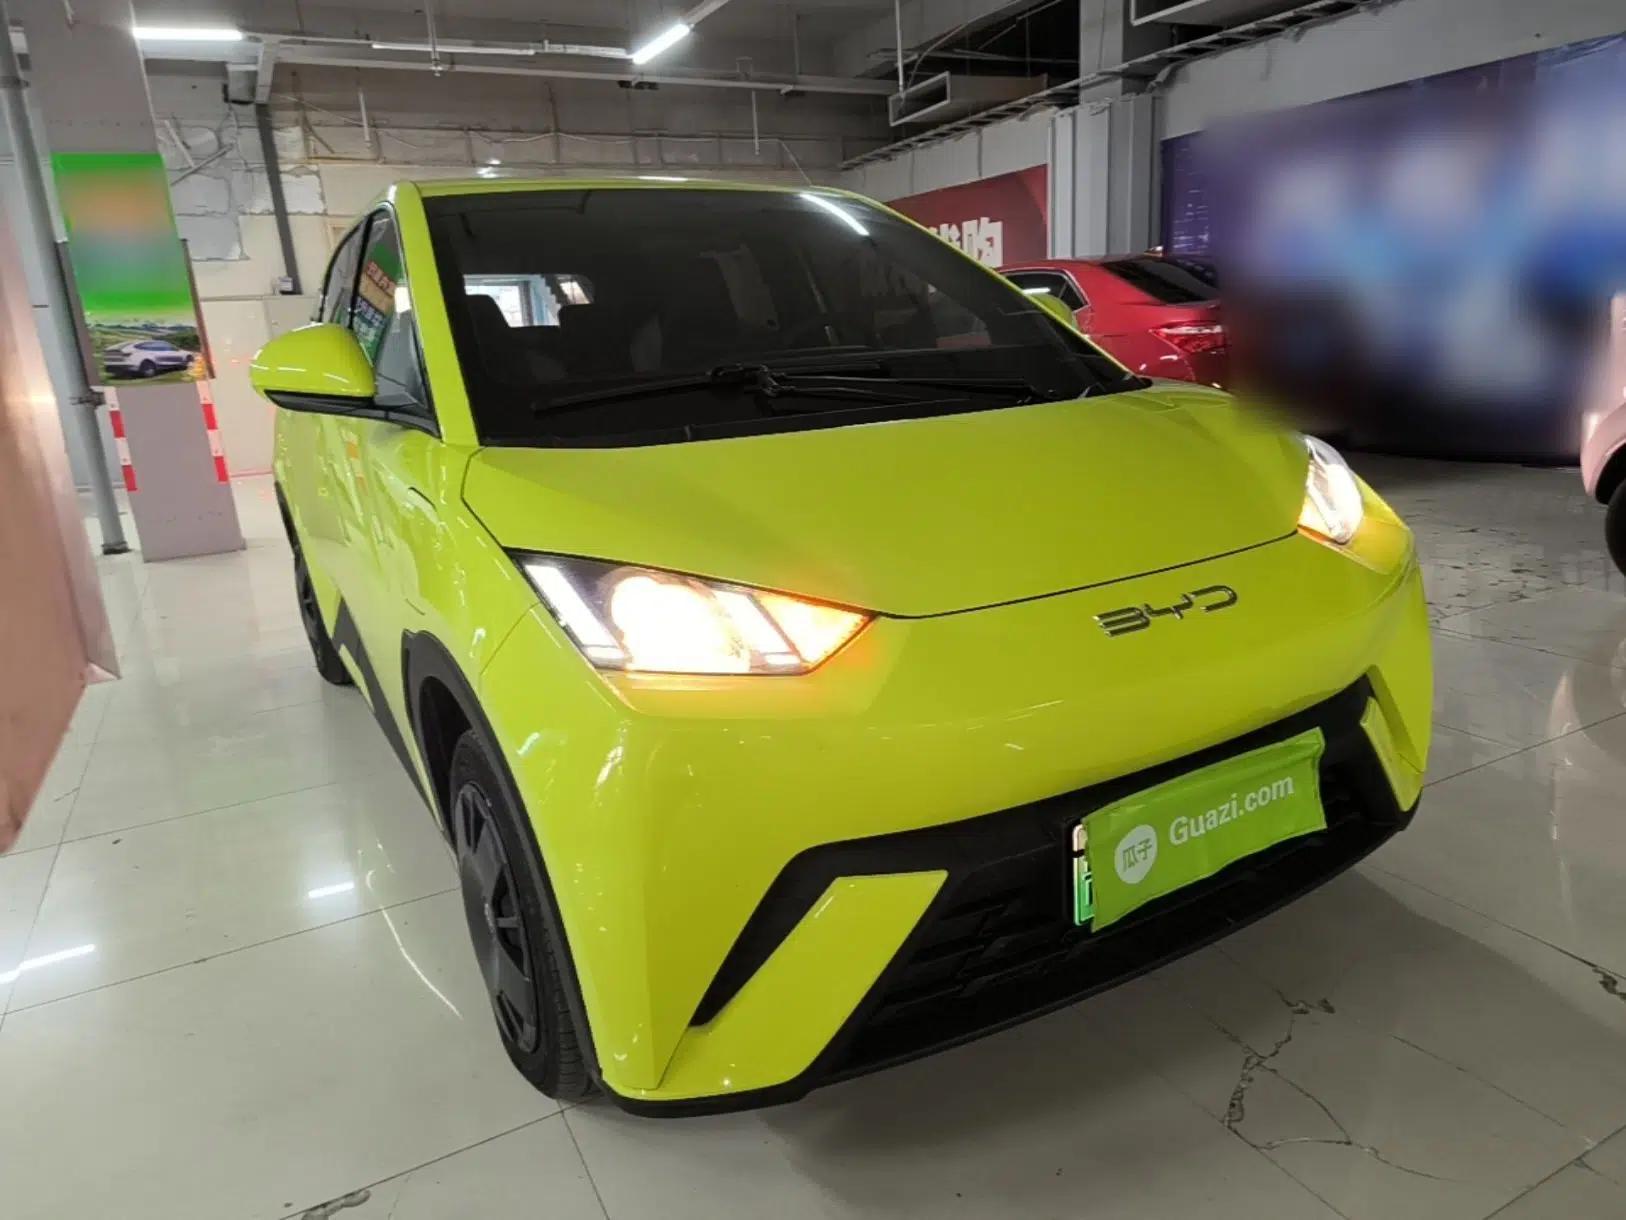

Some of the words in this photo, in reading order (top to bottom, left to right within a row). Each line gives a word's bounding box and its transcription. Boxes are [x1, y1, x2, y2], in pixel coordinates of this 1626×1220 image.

[1092, 585, 1237, 637] BYD
[1169, 776, 1295, 845] Guazi.com
[1122, 837, 1153, 872] 瓜子
